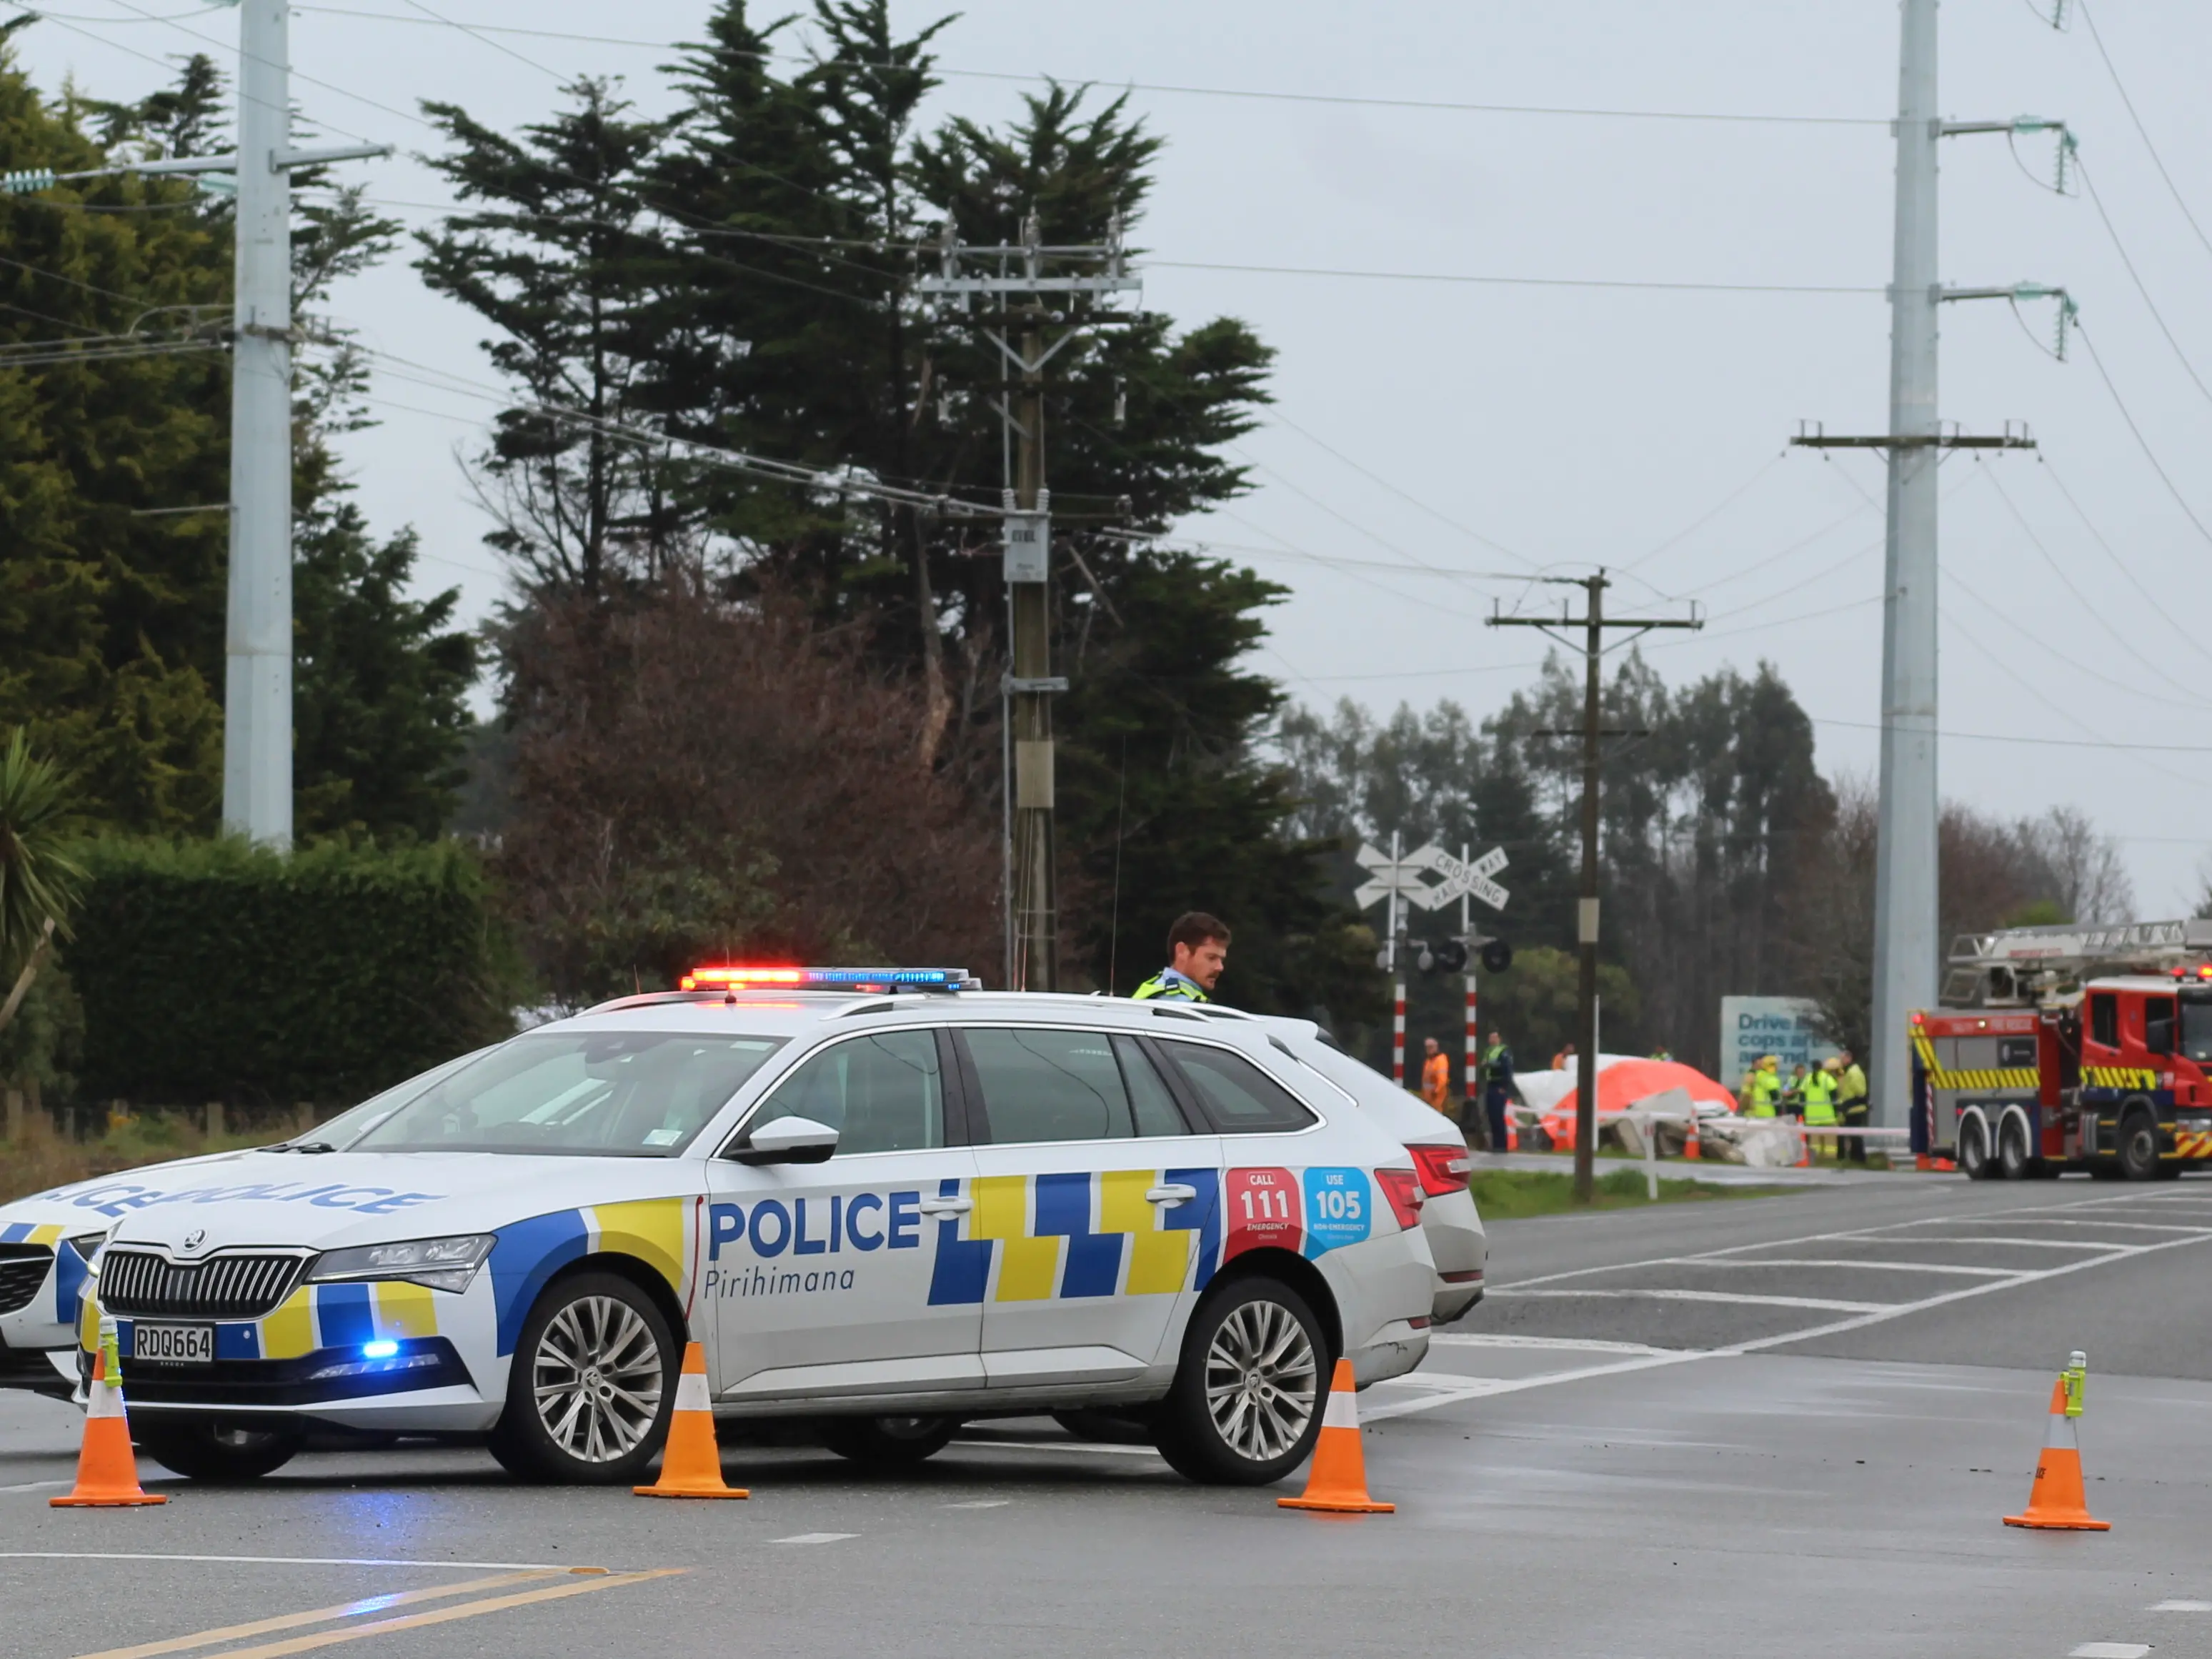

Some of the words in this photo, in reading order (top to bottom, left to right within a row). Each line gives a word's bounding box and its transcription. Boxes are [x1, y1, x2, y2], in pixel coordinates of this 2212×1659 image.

[1435, 854, 1501, 903] CROSSING
[1738, 1012, 1791, 1030] Drive
[1738, 1034, 1785, 1050] cops
[1250, 1175, 1275, 1185] CALL
[1326, 1175, 1344, 1185] USE
[143, 1182, 450, 1214] POLICE
[1240, 1190, 1289, 1219] 111
[1316, 1190, 1362, 1219] 105
[709, 1191, 921, 1261] POLICE
[1247, 1222, 1290, 1232] EMERGENCY
[704, 1266, 855, 1300] Pirihimana
[136, 1328, 211, 1357] RDQ664
